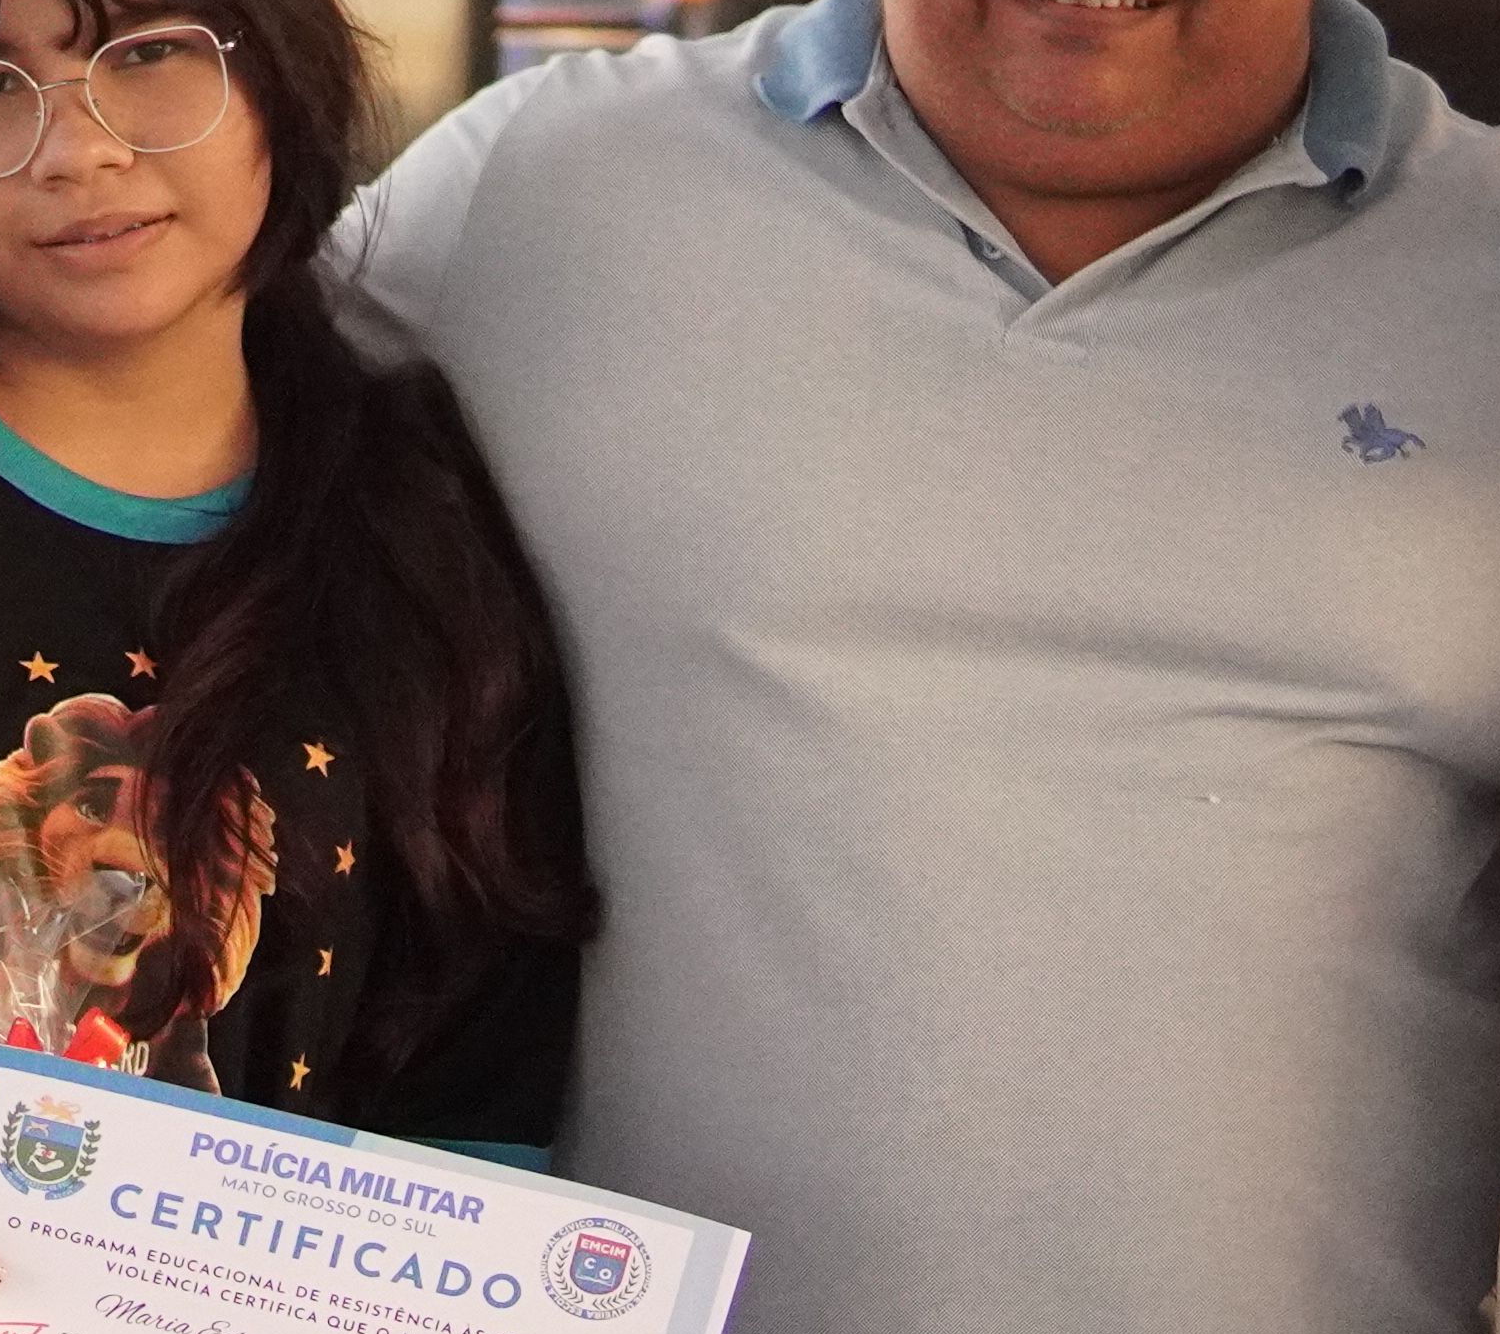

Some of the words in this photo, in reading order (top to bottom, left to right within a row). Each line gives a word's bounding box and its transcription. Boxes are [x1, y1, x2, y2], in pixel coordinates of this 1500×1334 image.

[189, 1131, 332, 1190] POLÍCIA
[338, 1166, 485, 1225] MILITAR
[221, 1175, 277, 1199] MATO
[283, 1189, 362, 1219] GROSSO
[367, 1209, 397, 1227] DO
[402, 1217, 437, 1238] SUL
[7, 1216, 22, 1230] O
[30, 1220, 137, 1258] PROGRAMA
[146, 1249, 286, 1294] EDUCACIONAL
[295, 1285, 321, 1303] DE
[328, 1293, 452, 1334] RESISTÊNCIA
[110, 1183, 522, 1309] CERTIFICADO
[581, 1239, 626, 1258] EMCIM
[106, 1260, 211, 1298] VIOLÊNCIA
[220, 1288, 317, 1324] CERTIFICA
